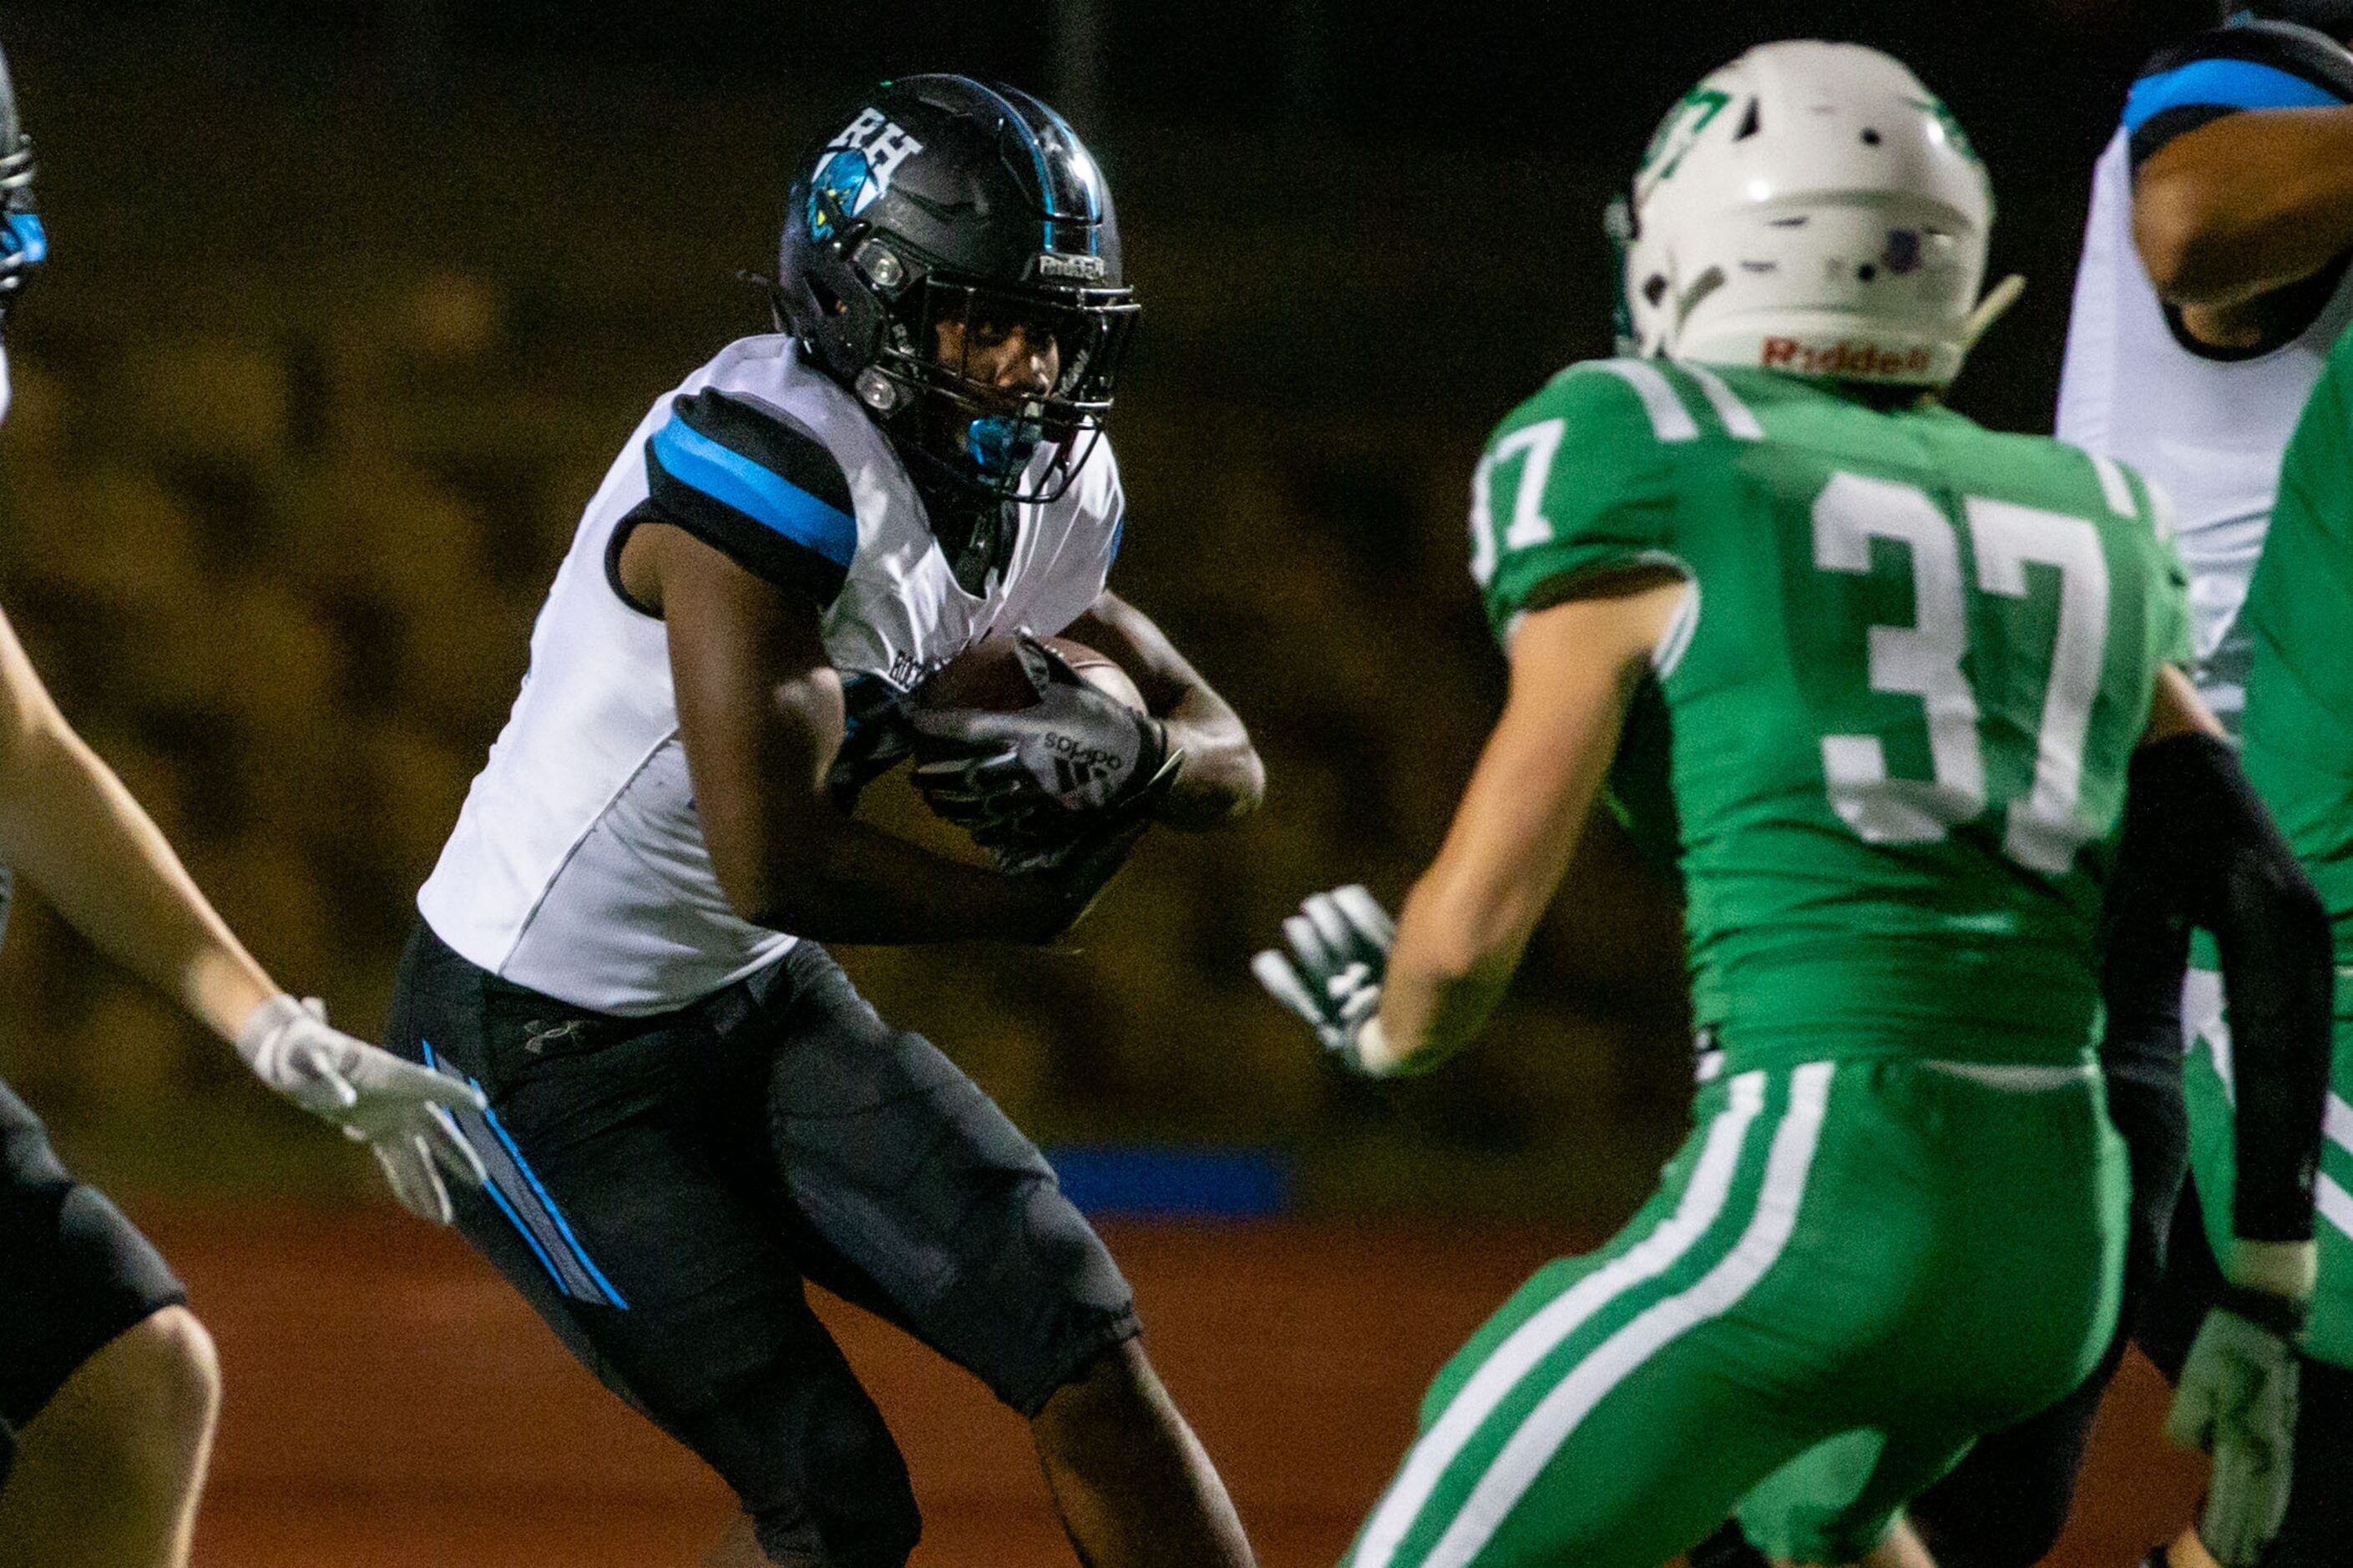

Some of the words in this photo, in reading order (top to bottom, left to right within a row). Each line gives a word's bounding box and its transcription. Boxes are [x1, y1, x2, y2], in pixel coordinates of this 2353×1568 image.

[827, 107, 923, 200] RH
[1761, 336, 1930, 373] Riddell
[1811, 471, 2108, 873] 37
[1044, 731, 1122, 771] adidas
